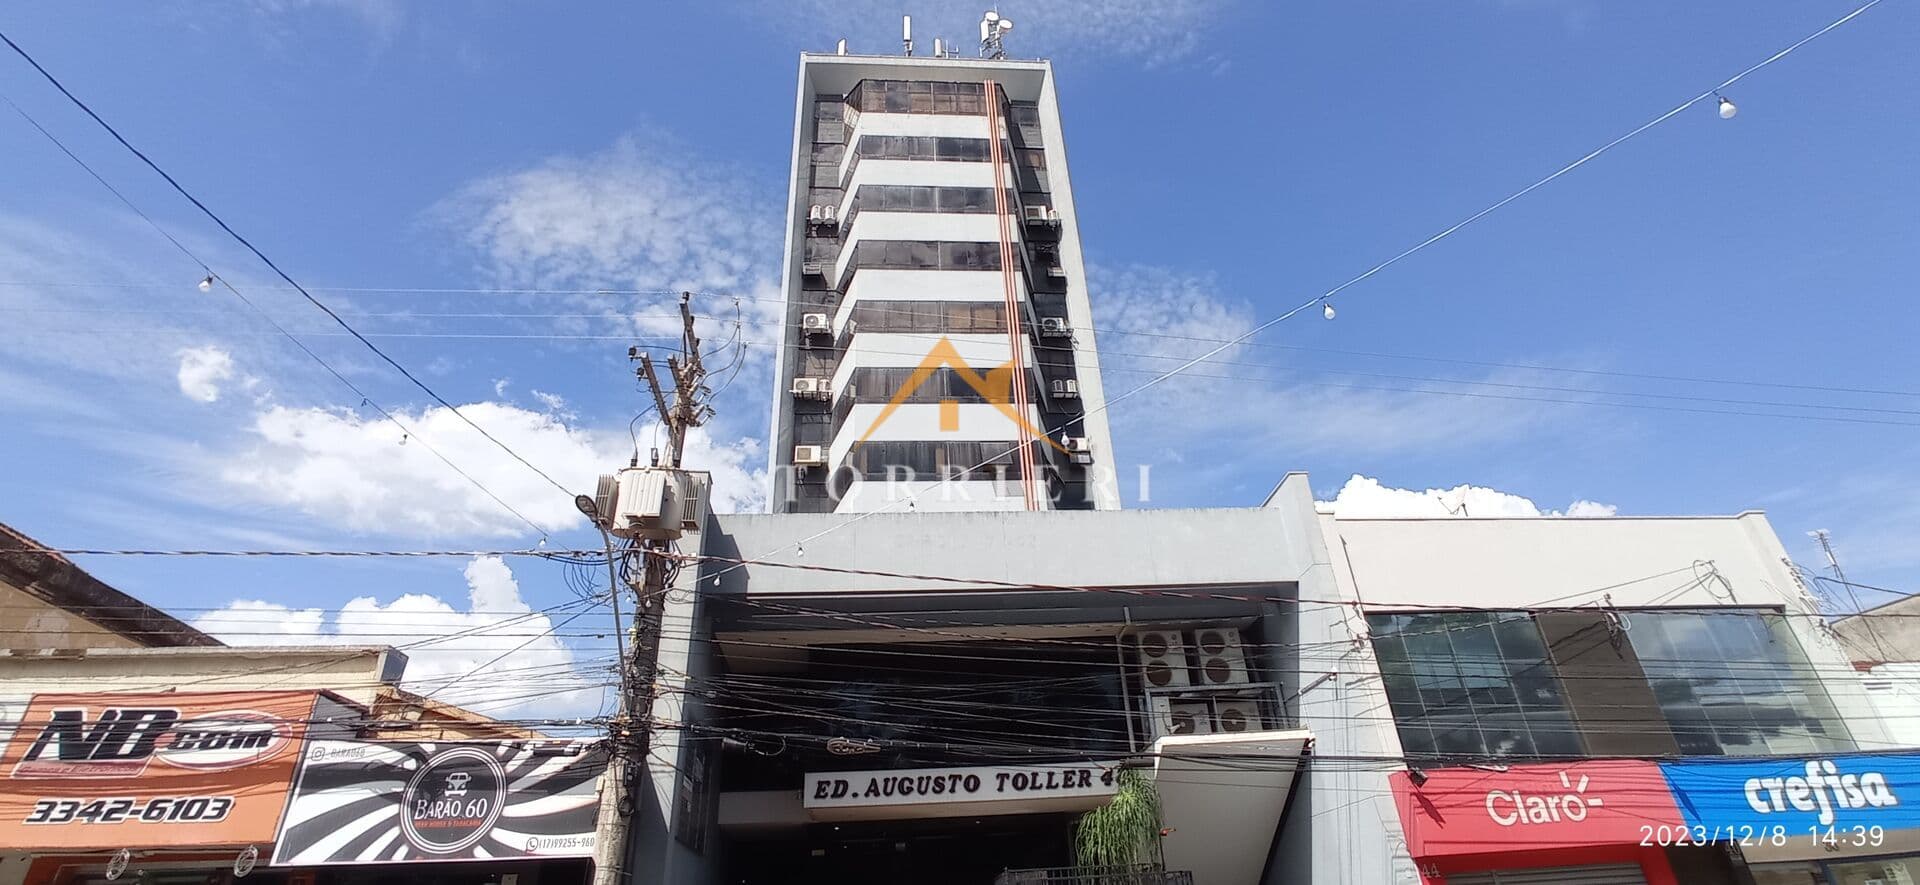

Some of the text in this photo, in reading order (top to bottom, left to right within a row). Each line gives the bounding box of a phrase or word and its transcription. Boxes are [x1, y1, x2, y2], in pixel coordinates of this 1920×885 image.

[863, 774, 981, 797] AUGUSTO
[996, 768, 1093, 793] TOLLER
[1743, 760, 1898, 825] crefisa
[24, 798, 235, 824] 3342-6103
[414, 798, 488, 819] BARÃO 60
[1485, 788, 1588, 826] Claro
[539, 837, 595, 849] (17)99255-960
